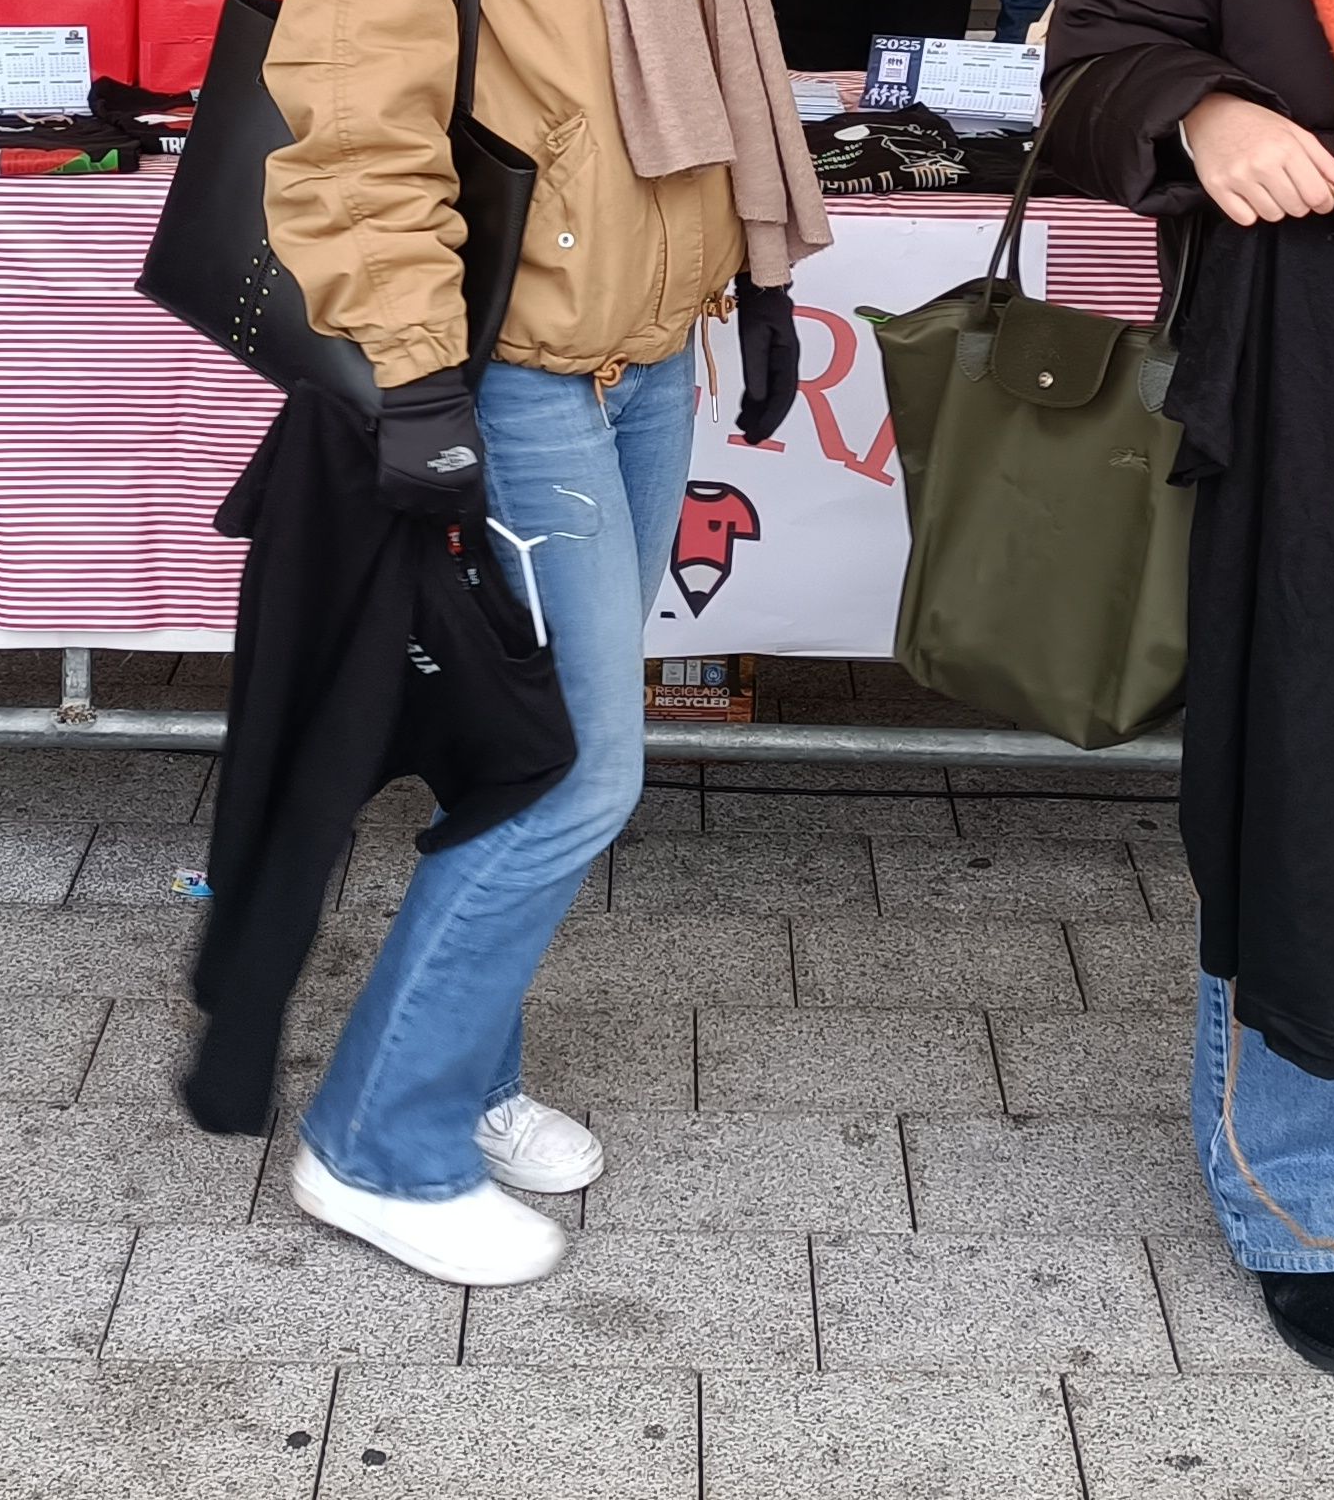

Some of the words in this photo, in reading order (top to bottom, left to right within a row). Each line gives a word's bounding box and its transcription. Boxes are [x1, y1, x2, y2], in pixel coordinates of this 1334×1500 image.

[874, 38, 921, 51] 2025
[655, 686, 730, 697] RECICLADO
[655, 697, 730, 708] RECYCLED
